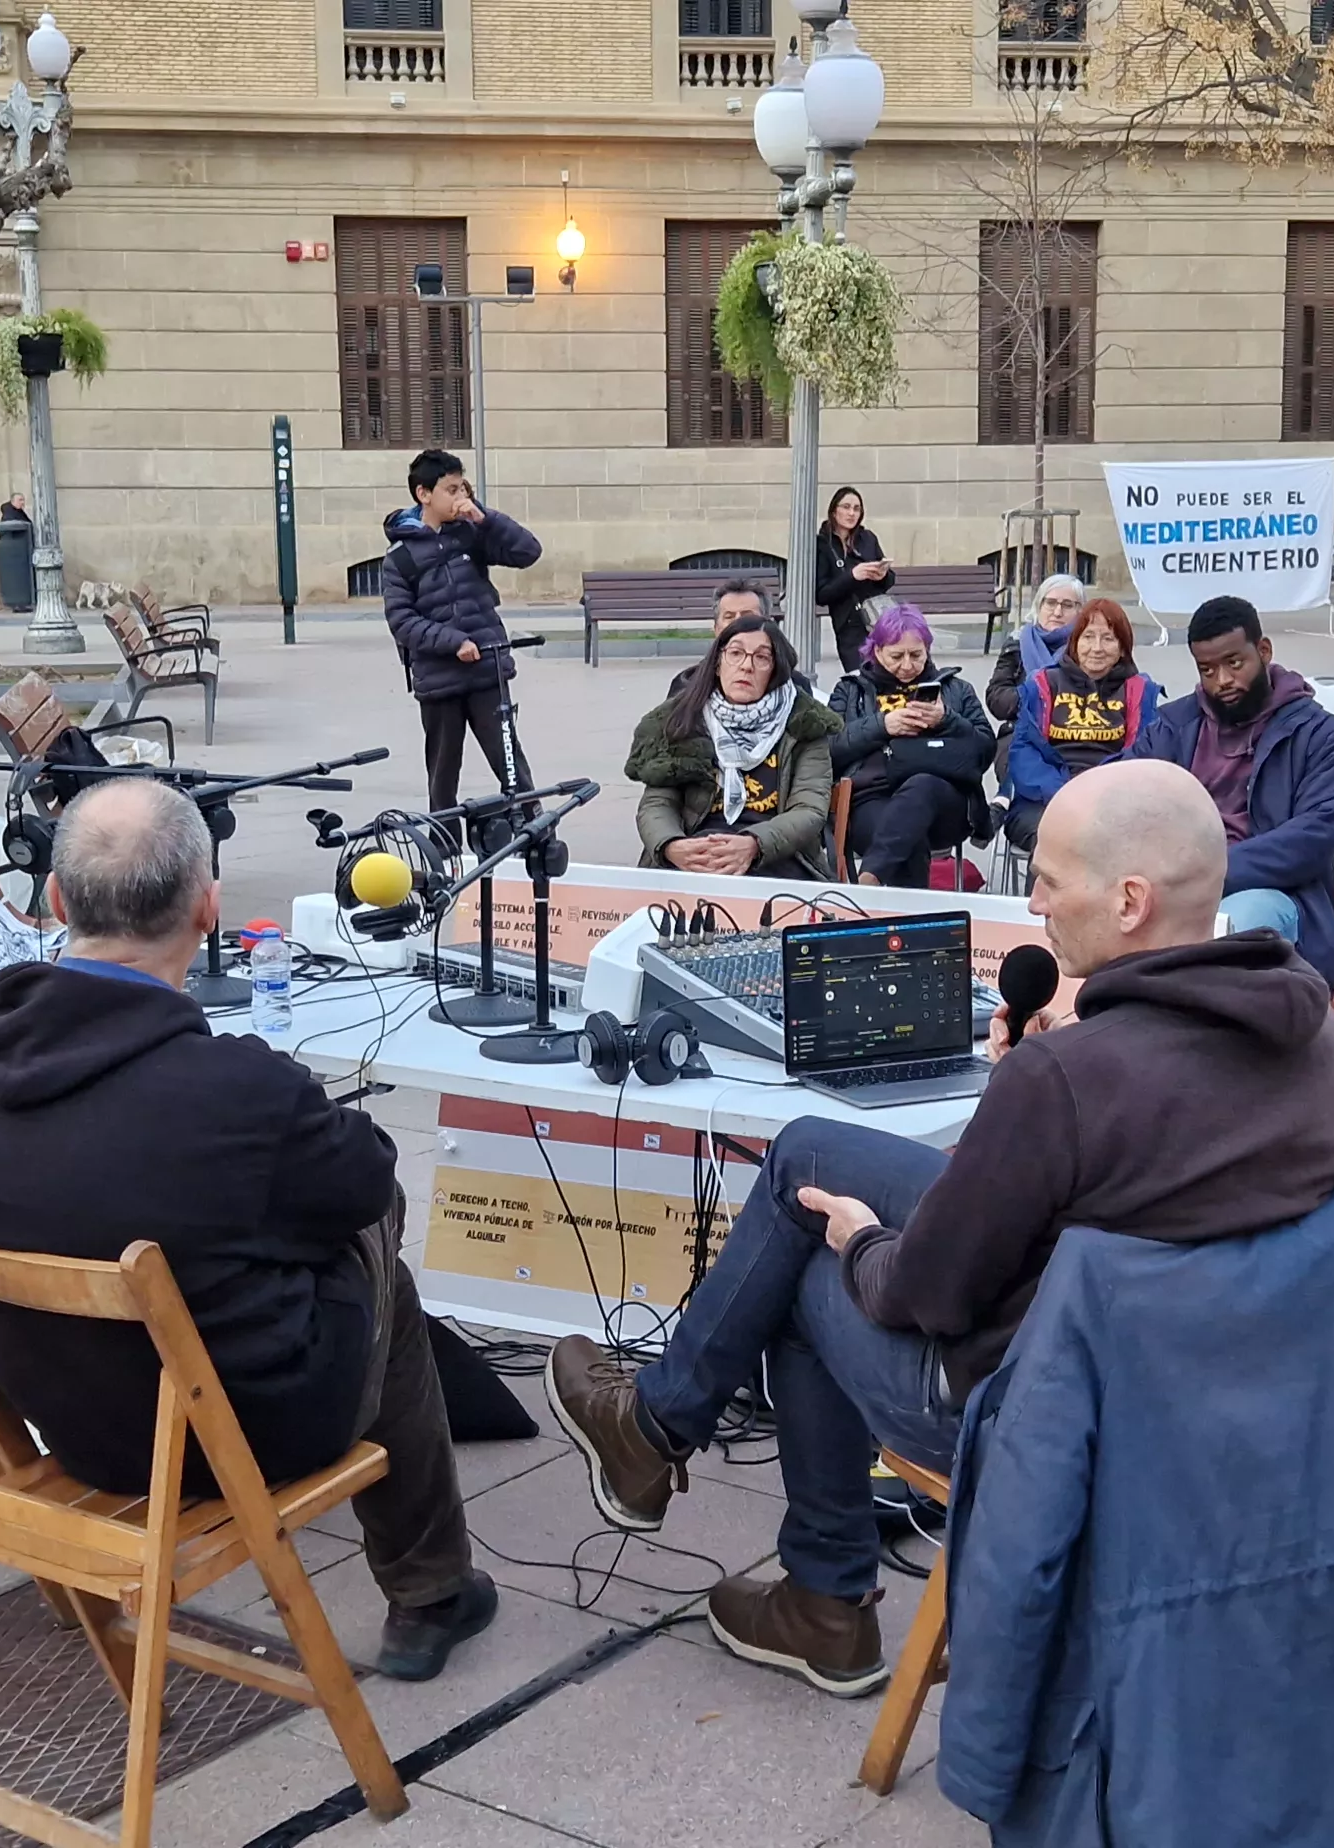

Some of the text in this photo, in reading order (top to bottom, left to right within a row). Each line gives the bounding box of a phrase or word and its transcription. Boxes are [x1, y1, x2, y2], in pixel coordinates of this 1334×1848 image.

[1126, 485, 1306, 508] NO PUEDE SER EL
[1123, 511, 1319, 545] MEDITERRÁNEO
[1130, 547, 1320, 574] UN CEMENTERIO
[581, 908, 620, 922] REVISIÓN
[492, 920, 511, 930] SILO
[971, 948, 1005, 960] EGULA
[450, 1193, 488, 1206] DERECHO
[491, 1198, 497, 1207] A
[443, 1209, 534, 1230] VIVIENDA PÚBLICA DE
[595, 1219, 612, 1230] POR
[466, 1229, 506, 1243] ALQUILER
